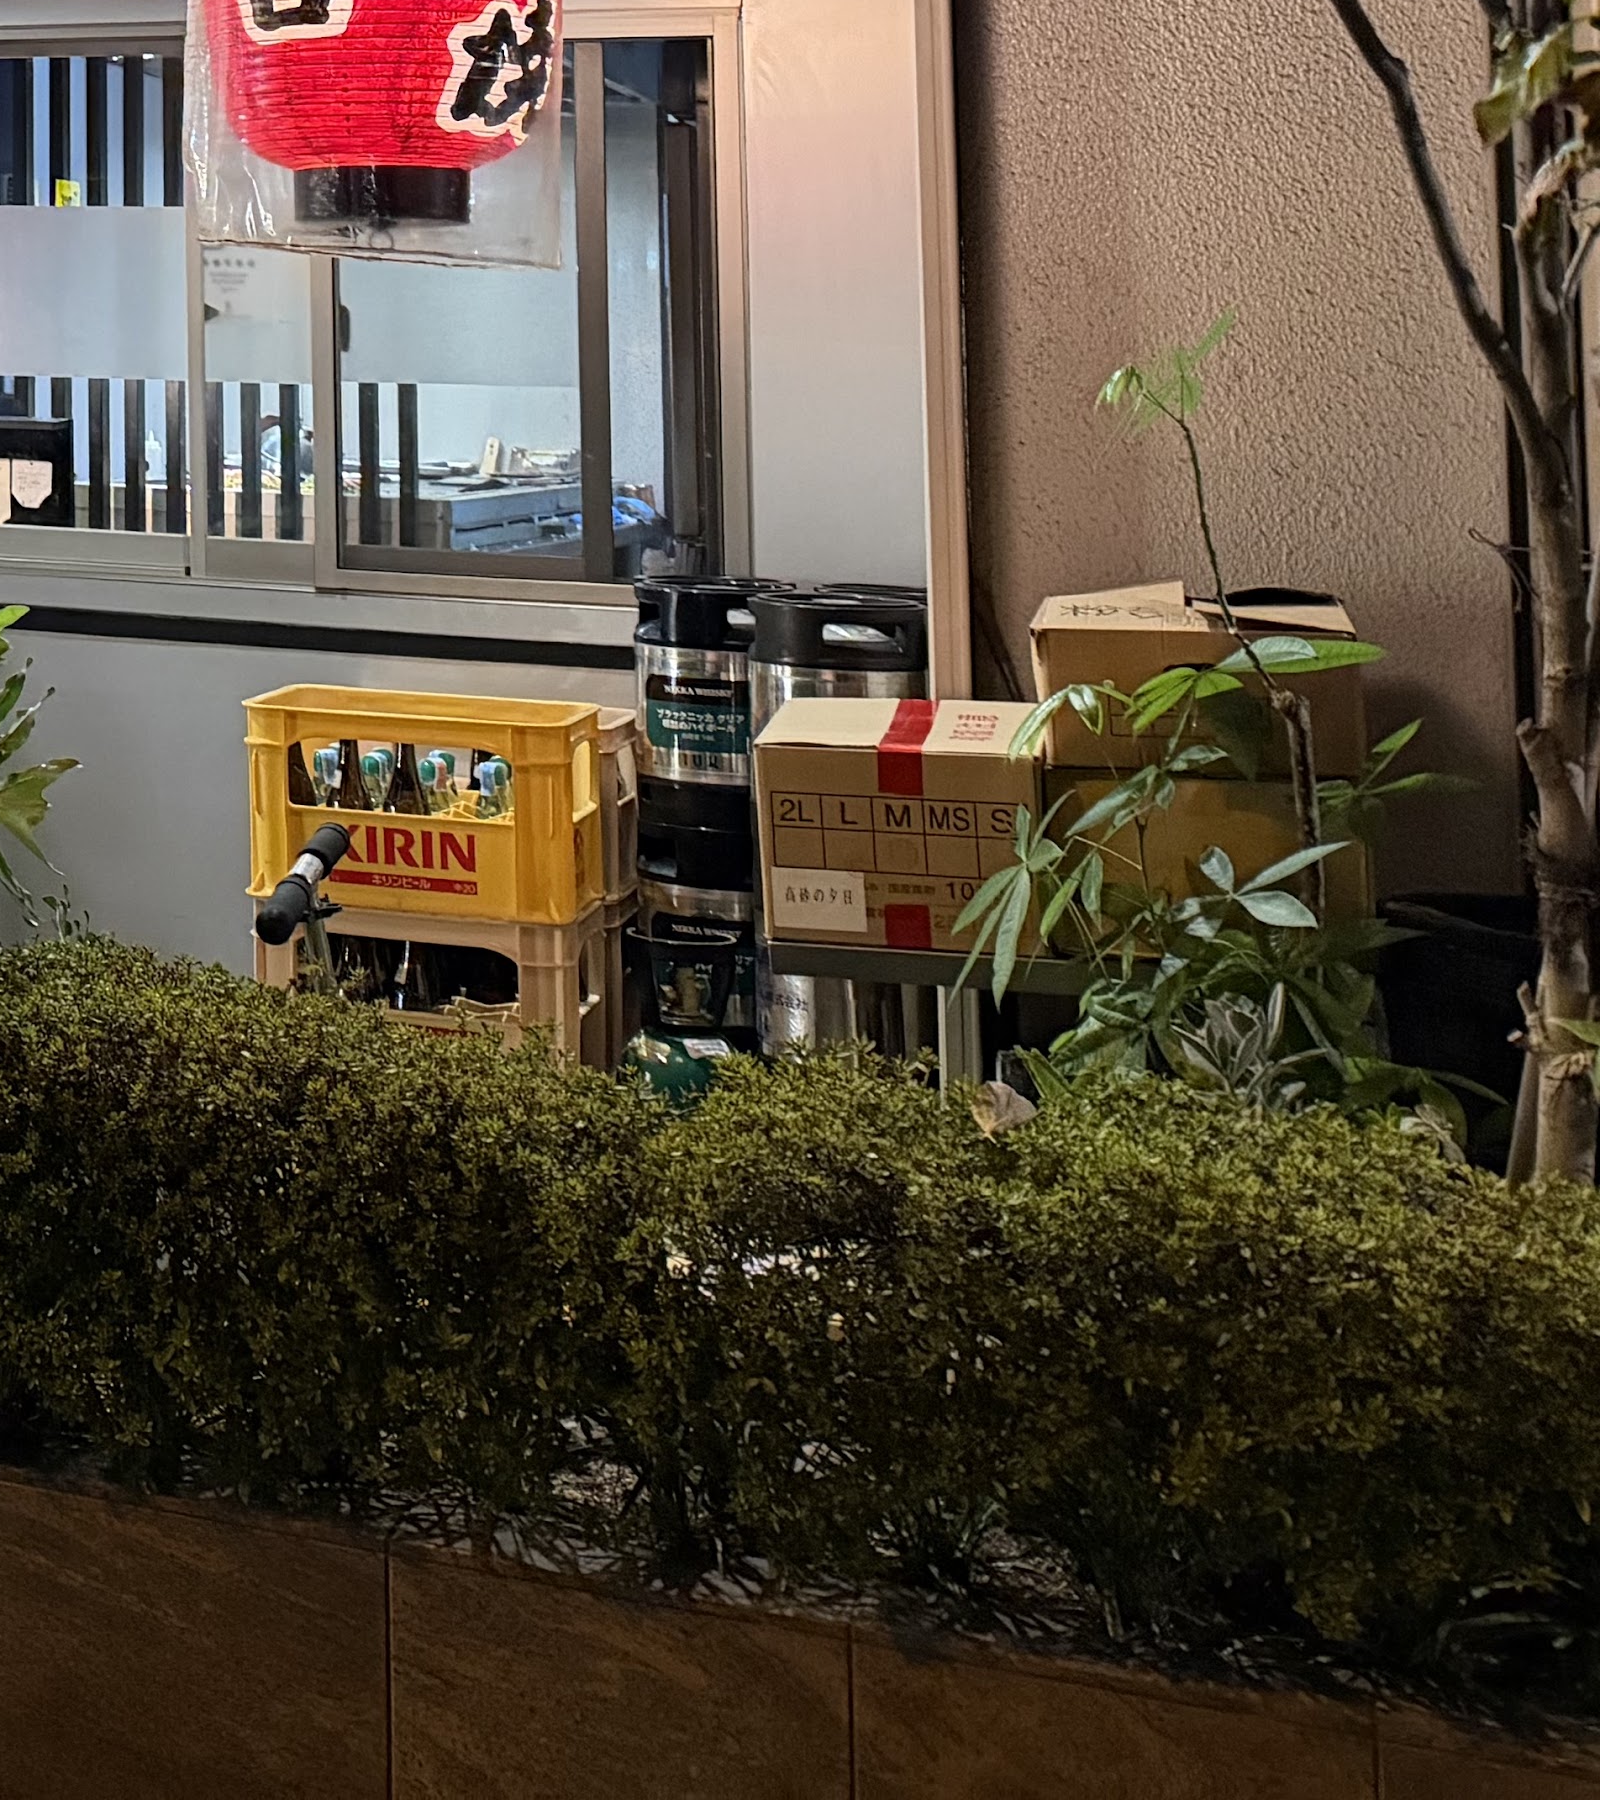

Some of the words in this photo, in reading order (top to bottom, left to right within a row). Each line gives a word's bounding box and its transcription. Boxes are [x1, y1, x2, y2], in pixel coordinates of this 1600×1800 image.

[780, 798, 814, 823] 2L
[840, 802, 858, 825] L
[884, 803, 911, 828] M
[929, 805, 970, 832] MS
[991, 809, 1013, 834] S
[371, 874, 432, 890] キリンビール
